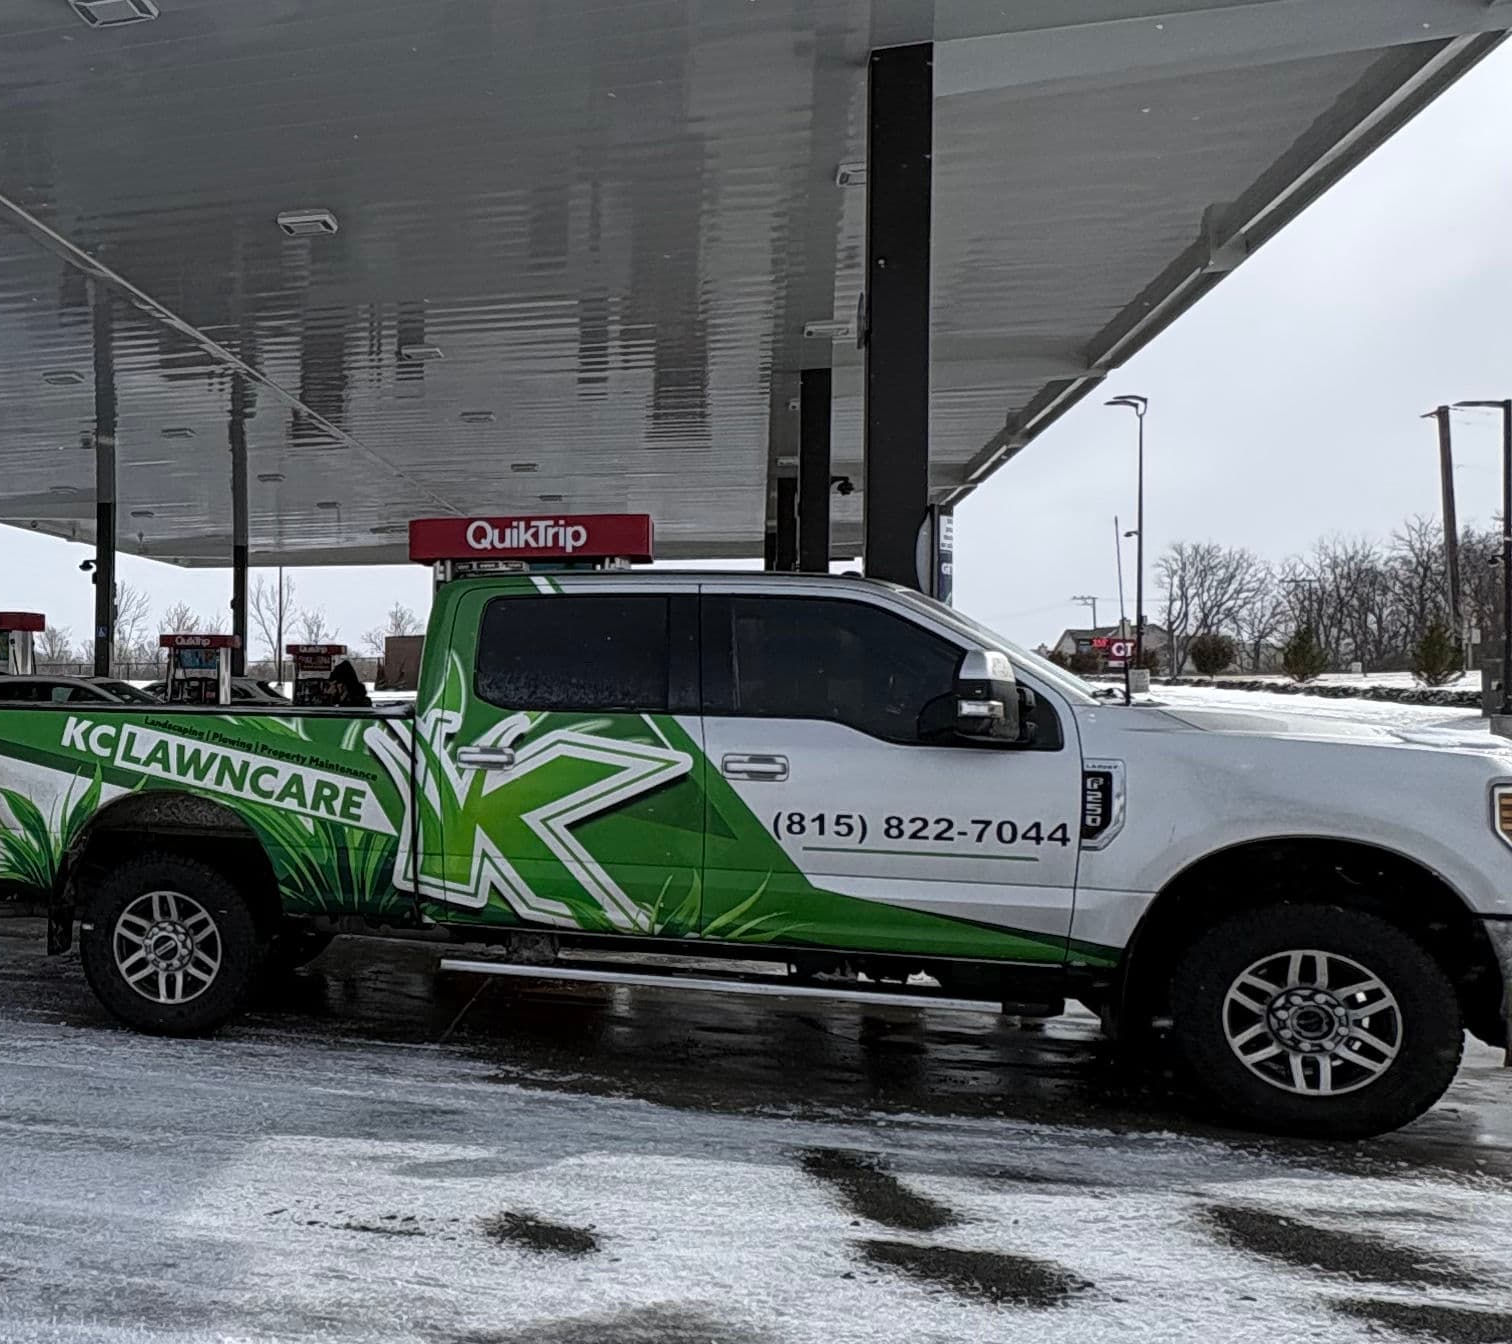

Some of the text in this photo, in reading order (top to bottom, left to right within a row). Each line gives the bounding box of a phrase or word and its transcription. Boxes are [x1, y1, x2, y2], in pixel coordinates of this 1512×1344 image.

[466, 520, 587, 552] QuikTrip
[1111, 642, 1135, 657] QT
[144, 715, 204, 741] Landscaping
[211, 732, 253, 752] Plowing
[261, 744, 308, 765] Property
[309, 755, 379, 782] Maintenance
[61, 716, 367, 822] KC LAWNCARE
[773, 811, 1071, 847] (815) 822-7044
